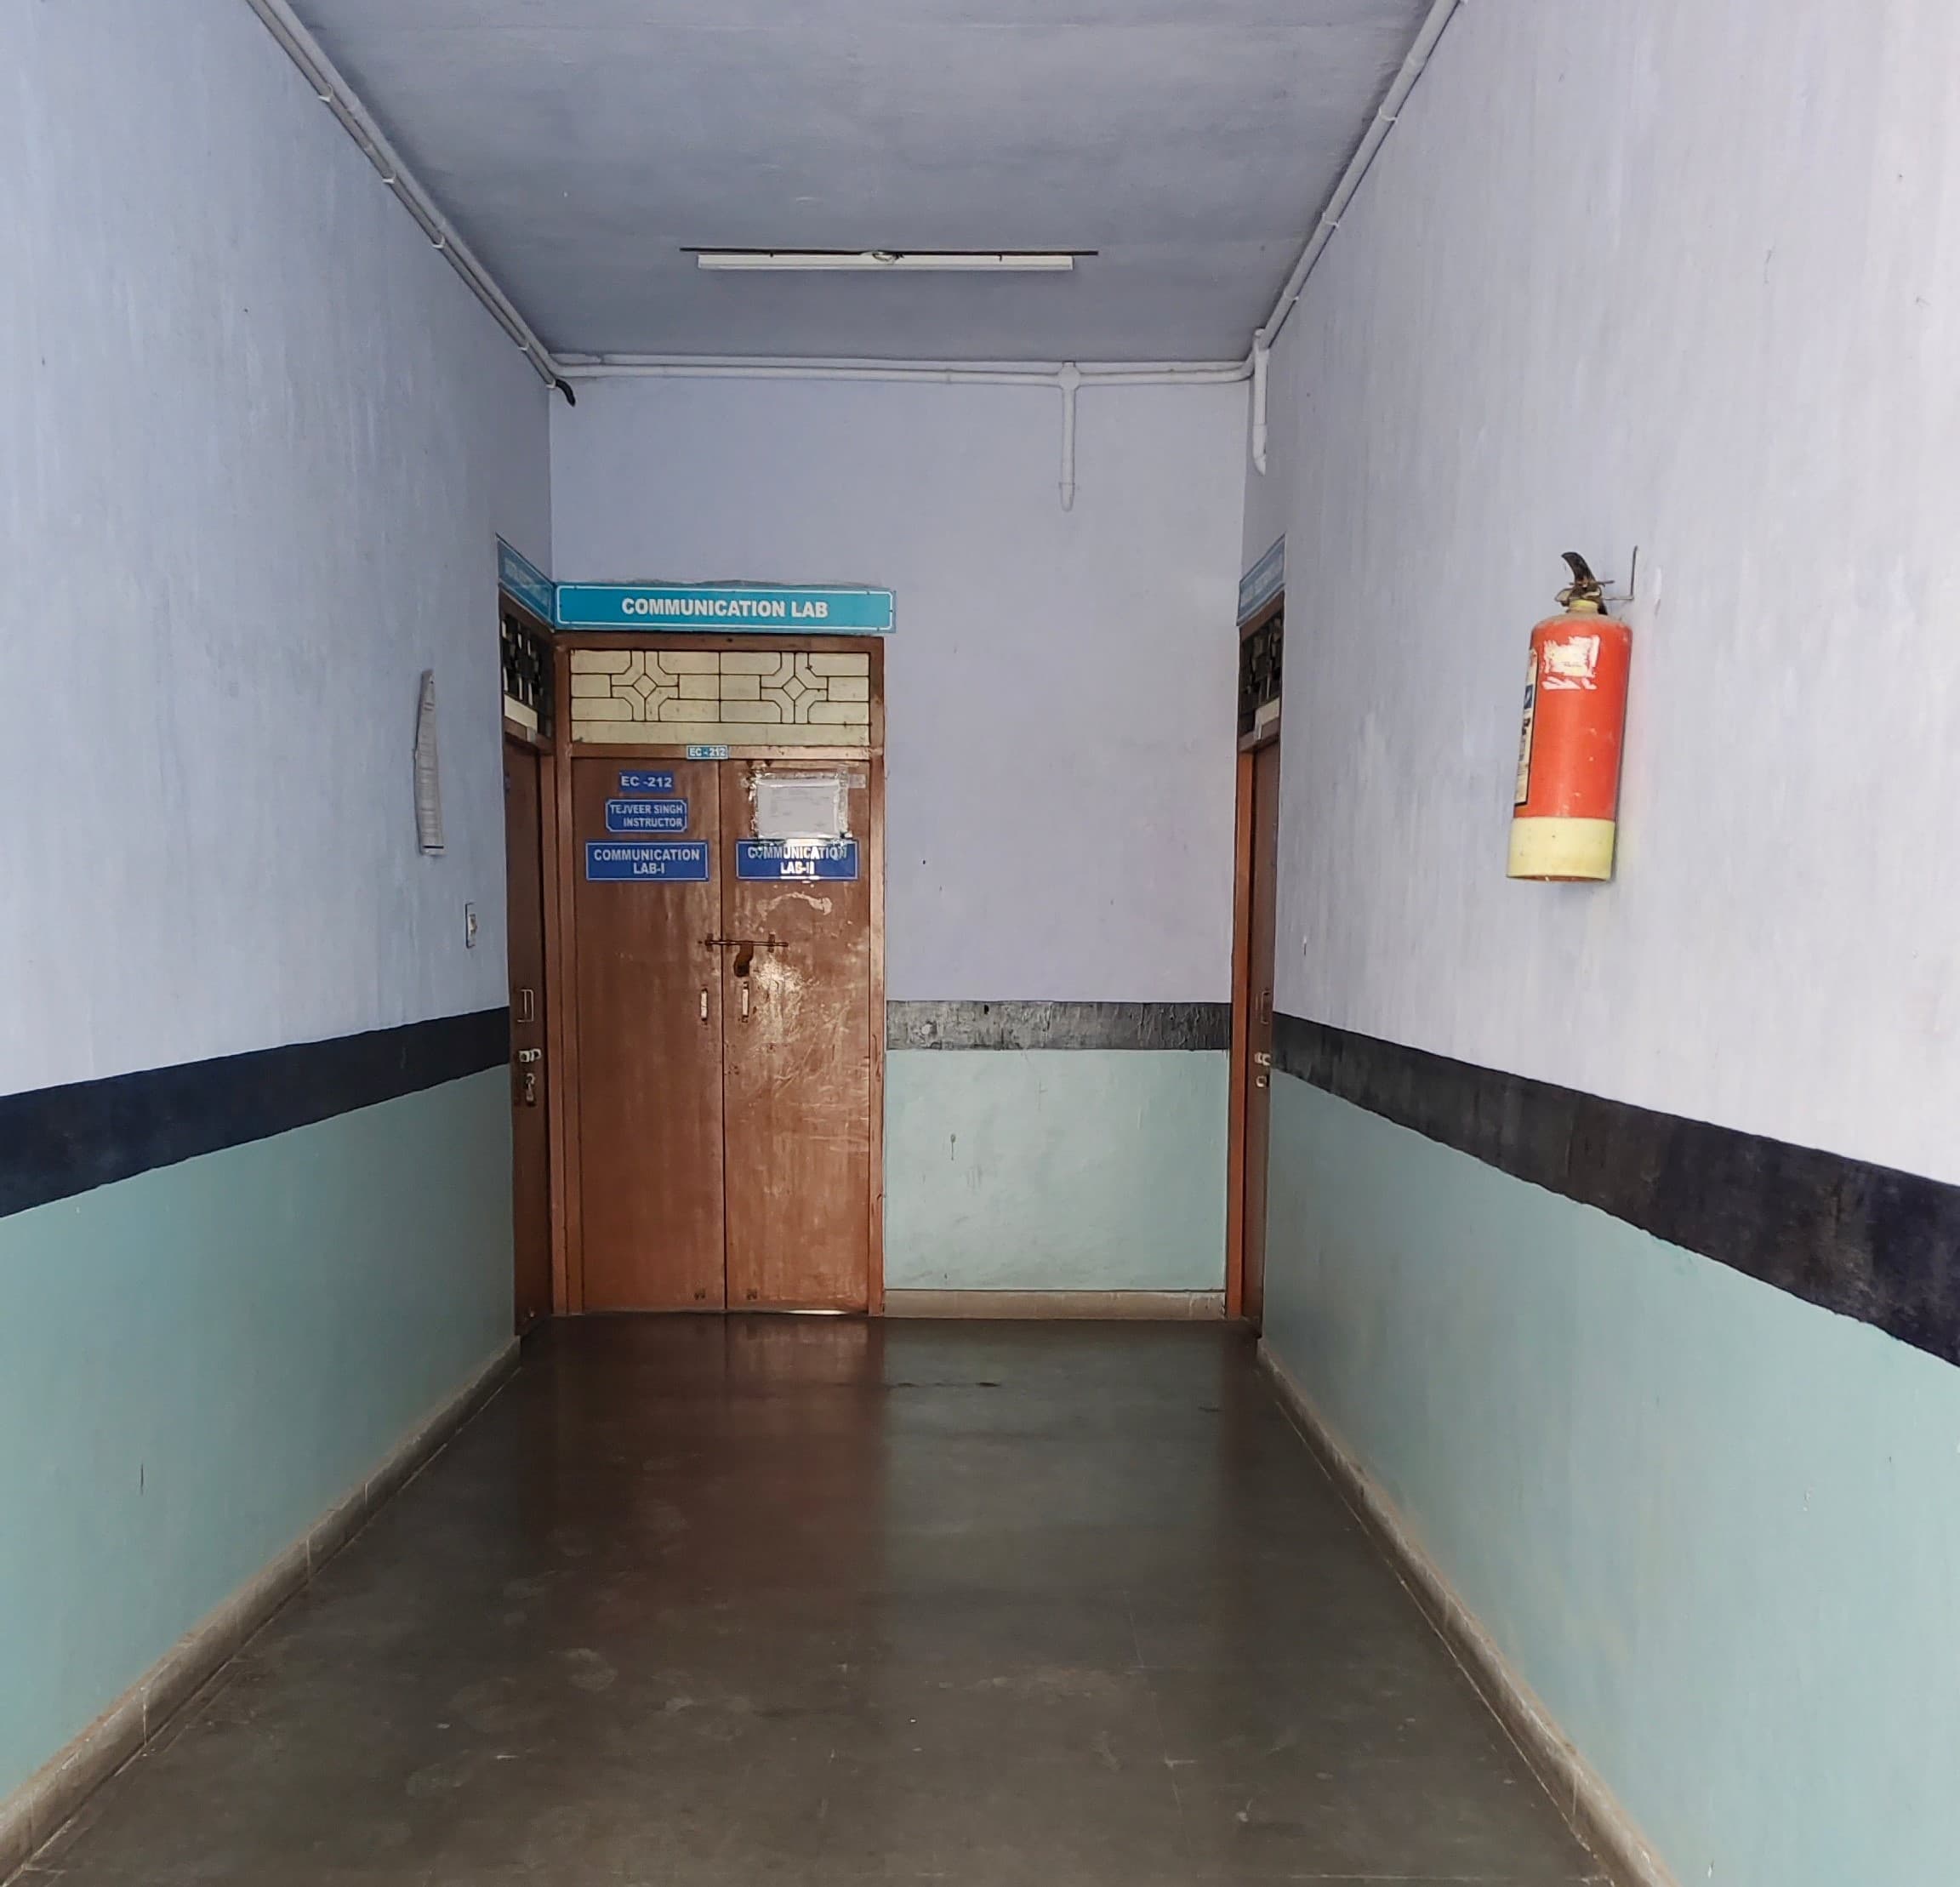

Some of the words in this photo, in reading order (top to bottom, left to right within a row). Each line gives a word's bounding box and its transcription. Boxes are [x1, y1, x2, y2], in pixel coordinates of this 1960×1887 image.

[621, 597, 786, 618] COMMUNICATION
[790, 601, 829, 619] LAB
[609, 804, 652, 814] TEJVEER
[653, 804, 683, 814] SINGH
[623, 818, 683, 828] INSTRUCTOR
[594, 848, 701, 862] COMMUNICATION
[632, 863, 665, 875] LAB-I
